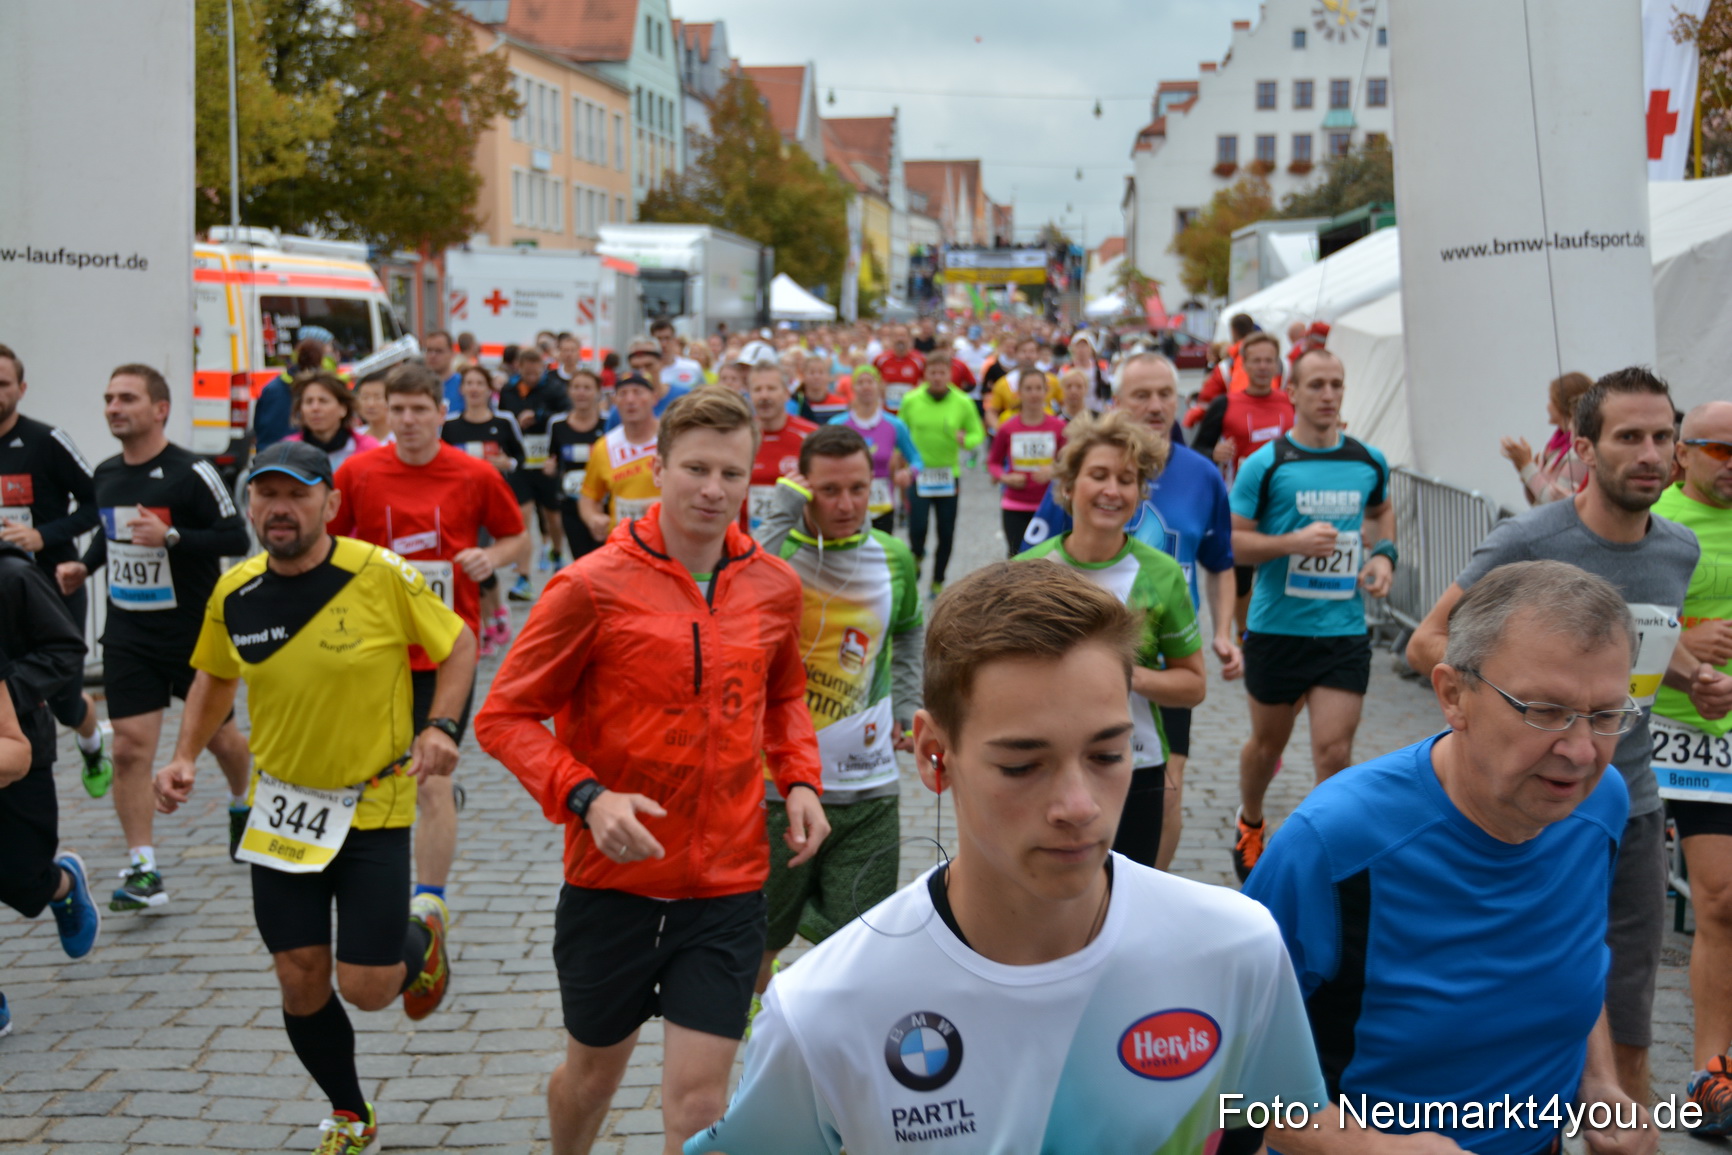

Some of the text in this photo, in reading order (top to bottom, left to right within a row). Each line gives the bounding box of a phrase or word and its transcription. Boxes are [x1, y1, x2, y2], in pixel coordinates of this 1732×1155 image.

[1440, 230, 1646, 262] www.bmw-laufsport.de
[1296, 490, 1361, 506] HUBER
[113, 559, 162, 585] 2497
[233, 625, 289, 647] Bernd W.
[1651, 730, 1732, 768] 2343
[1669, 772, 1710, 788] Benno
[269, 794, 331, 840] 344
[268, 838, 306, 861] Bernd
[889, 1012, 955, 1044] BMW
[1132, 1026, 1210, 1061] Hervis
[891, 1098, 975, 1127] PARTL
[894, 1119, 978, 1143] Neumarkt
